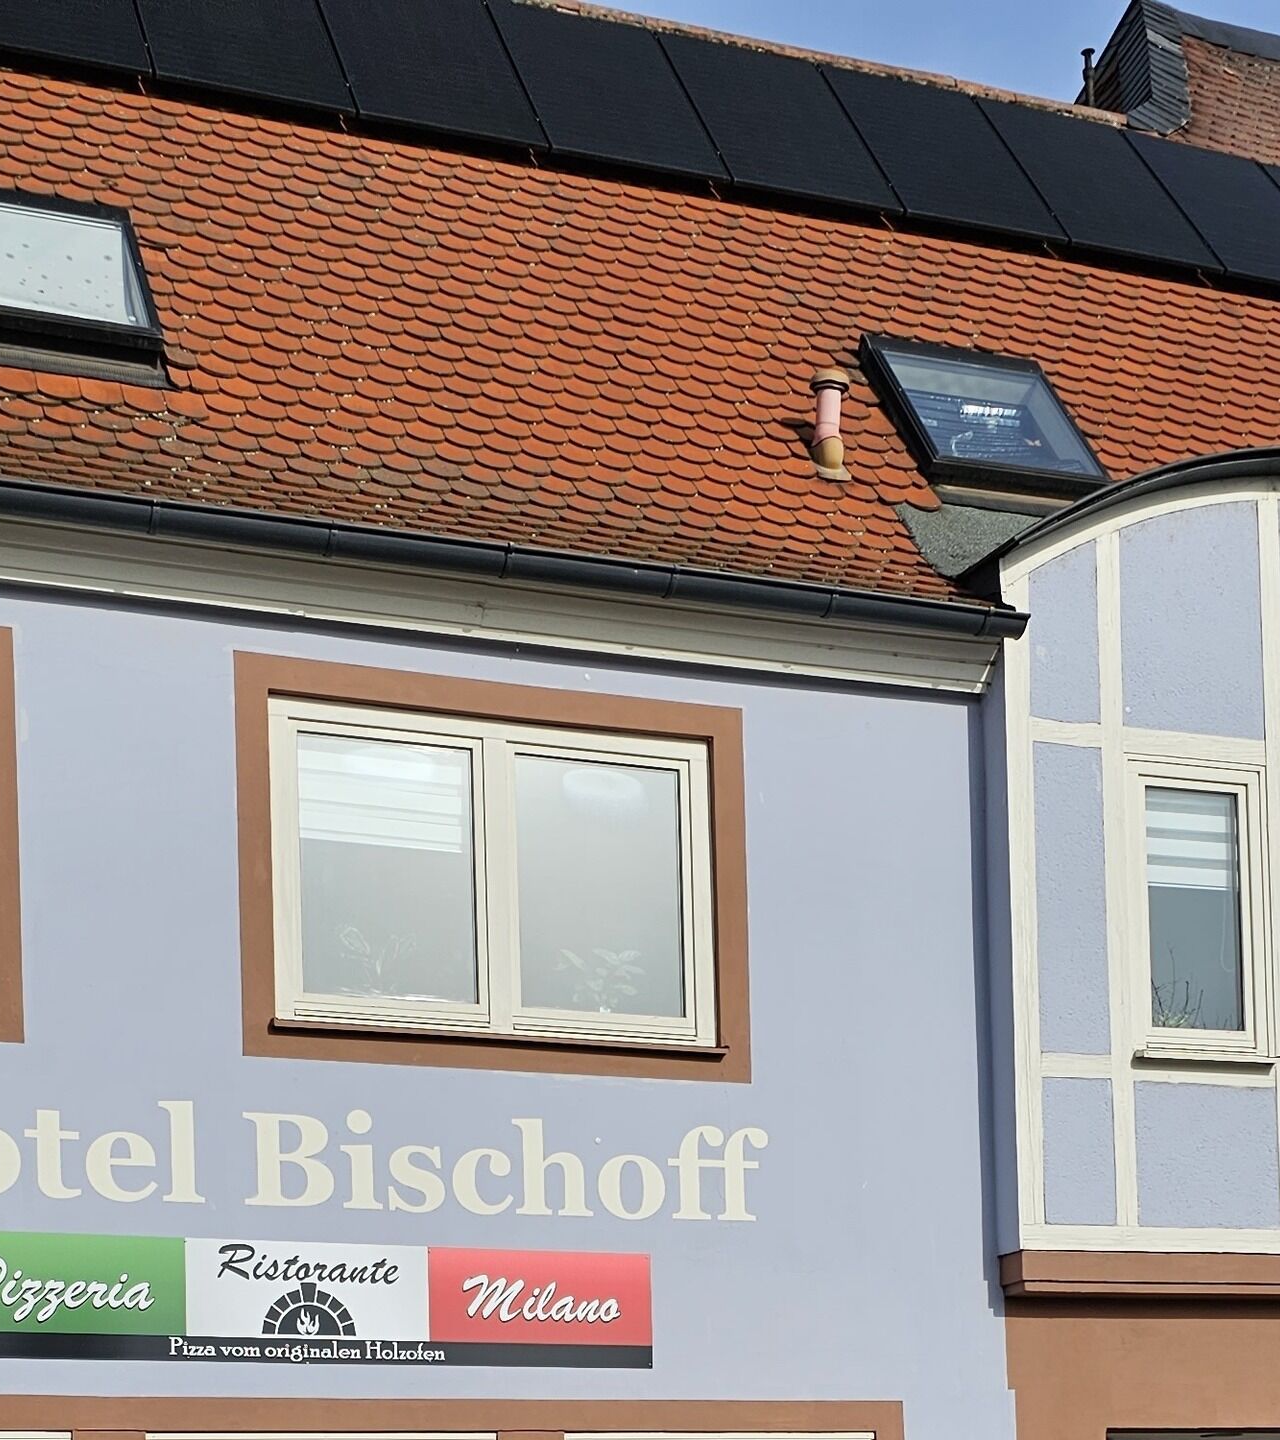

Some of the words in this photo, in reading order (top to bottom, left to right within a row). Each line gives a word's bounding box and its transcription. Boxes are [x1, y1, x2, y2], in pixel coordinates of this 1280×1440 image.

[242, 1109, 769, 1222] Bischoff
[217, 1243, 400, 1285] Ristorante
[462, 1274, 621, 1323] Milano
[169, 1336, 217, 1359] Pizza
[219, 1345, 261, 1358] vom
[263, 1341, 362, 1363] originalen
[365, 1341, 446, 1363] Holzofen
